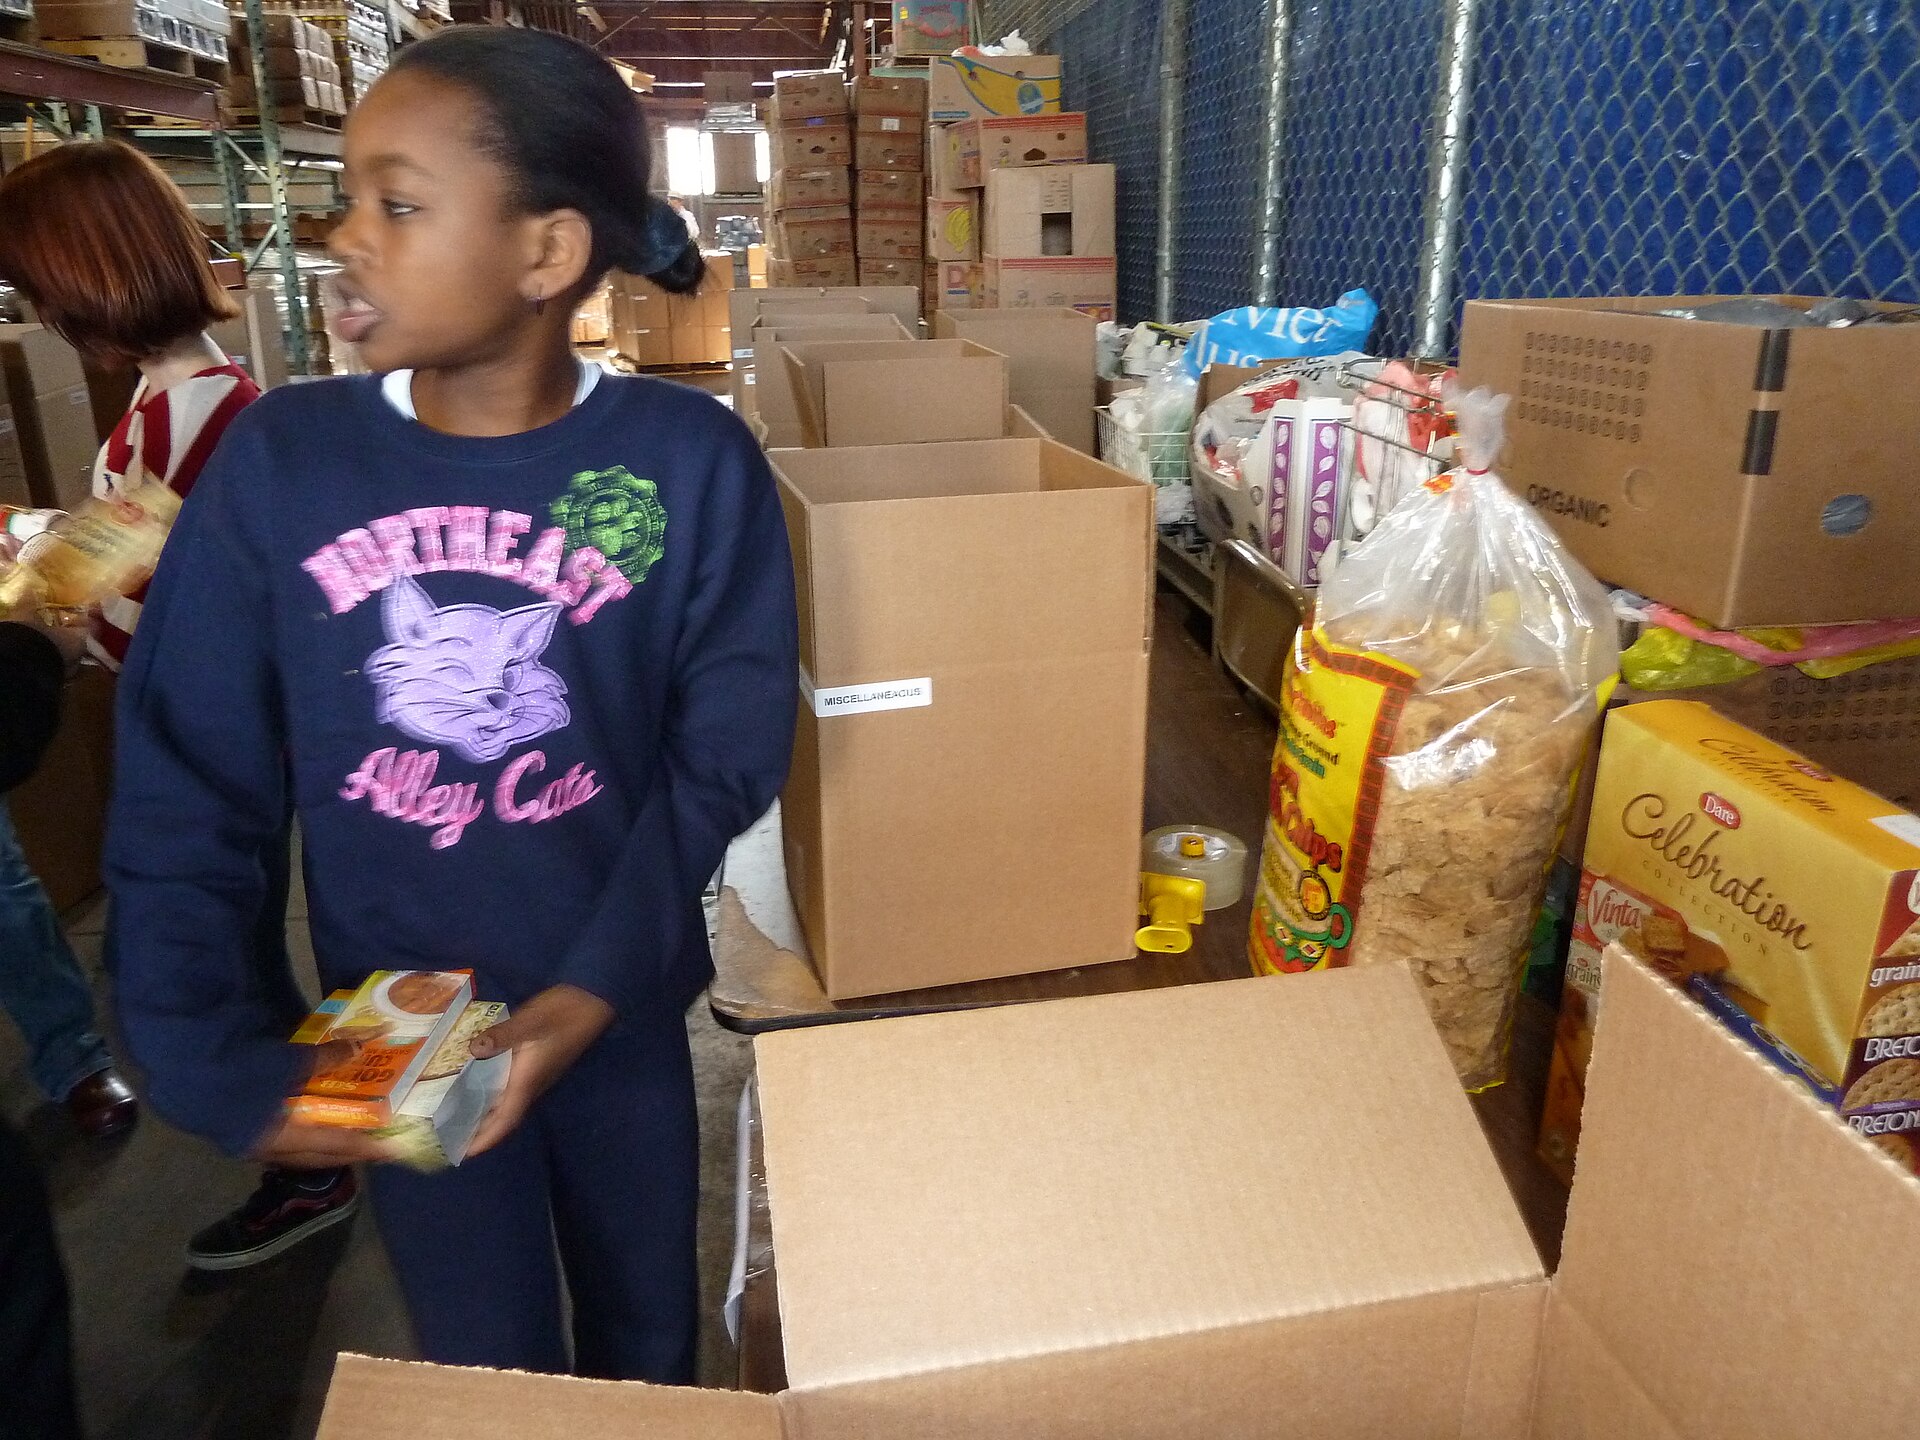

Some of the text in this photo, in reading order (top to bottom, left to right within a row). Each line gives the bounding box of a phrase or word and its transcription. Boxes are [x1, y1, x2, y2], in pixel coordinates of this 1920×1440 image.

[1526, 483, 1611, 528] ORGANIC
[338, 746, 605, 850] Alley Cats
[1703, 796, 1736, 825] Dare
[1622, 793, 1812, 950] Celebration
[1592, 889, 1642, 929] Vinta
[1642, 859, 1767, 955] COLLECTION
